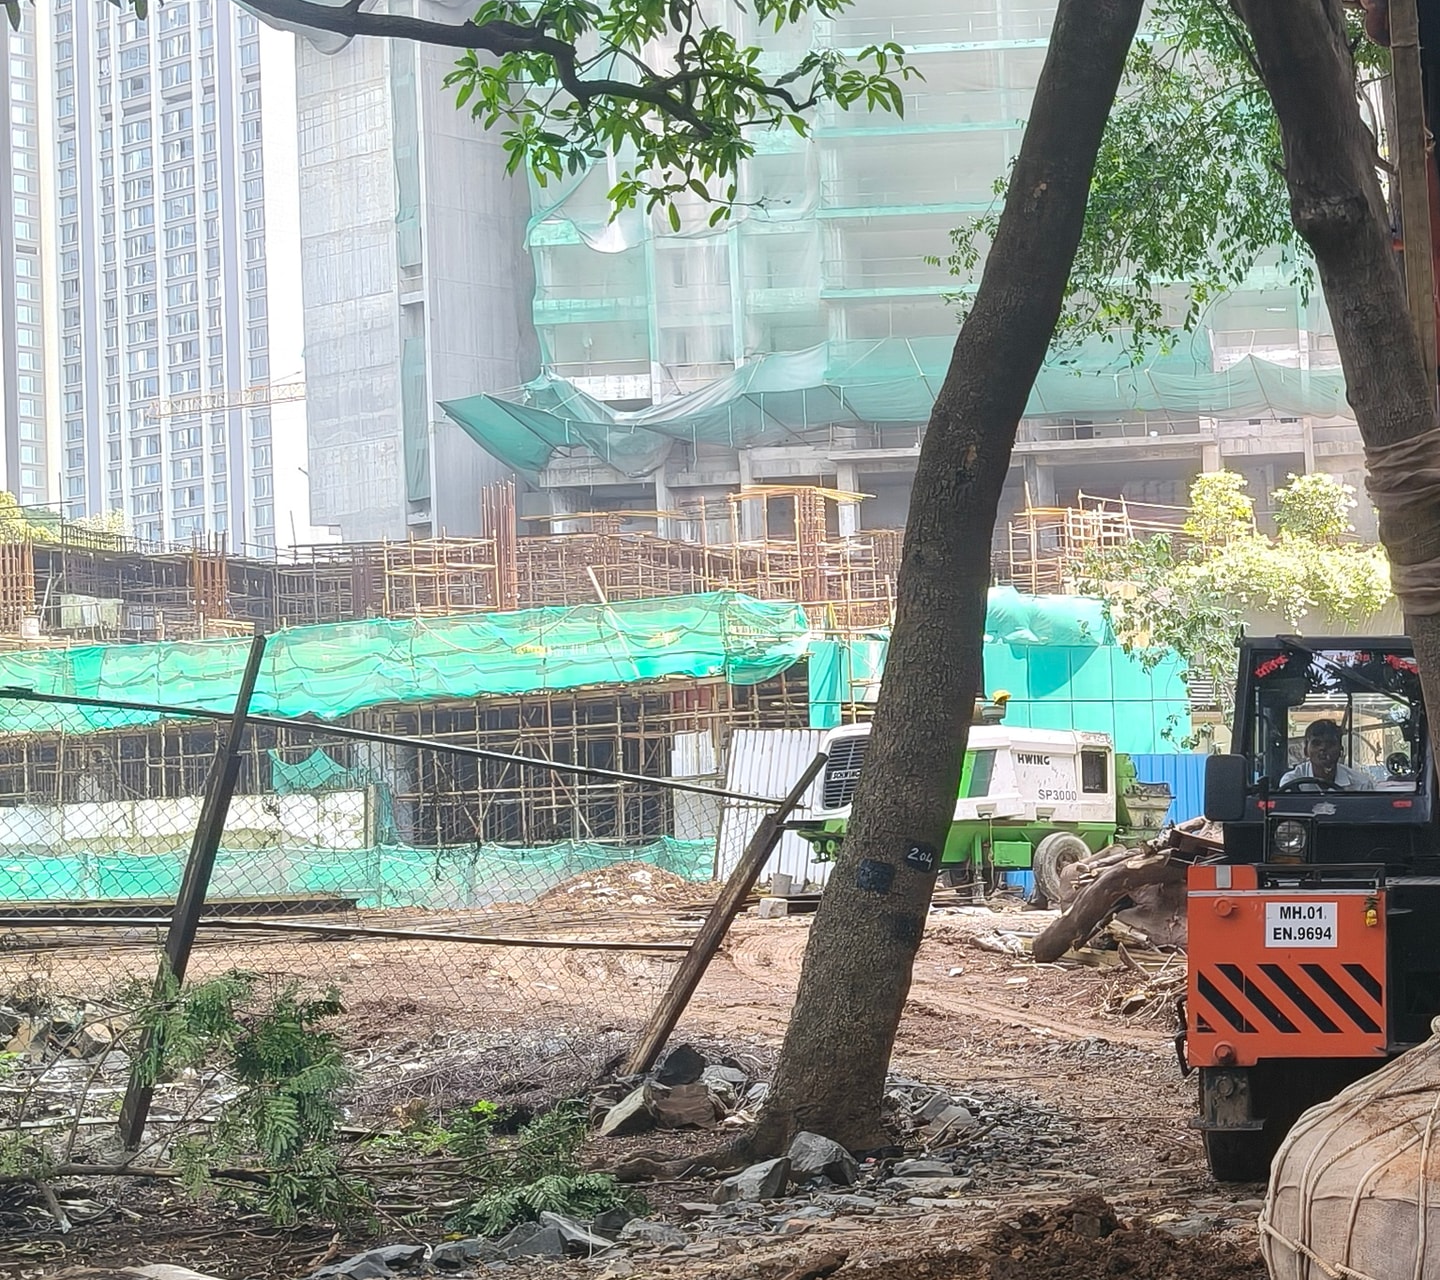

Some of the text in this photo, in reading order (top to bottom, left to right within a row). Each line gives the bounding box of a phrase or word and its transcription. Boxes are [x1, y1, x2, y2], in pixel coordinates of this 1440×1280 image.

[1038, 788, 1077, 801] SP3000
[907, 847, 934, 870] 204
[1273, 926, 1332, 941] EN.9694
